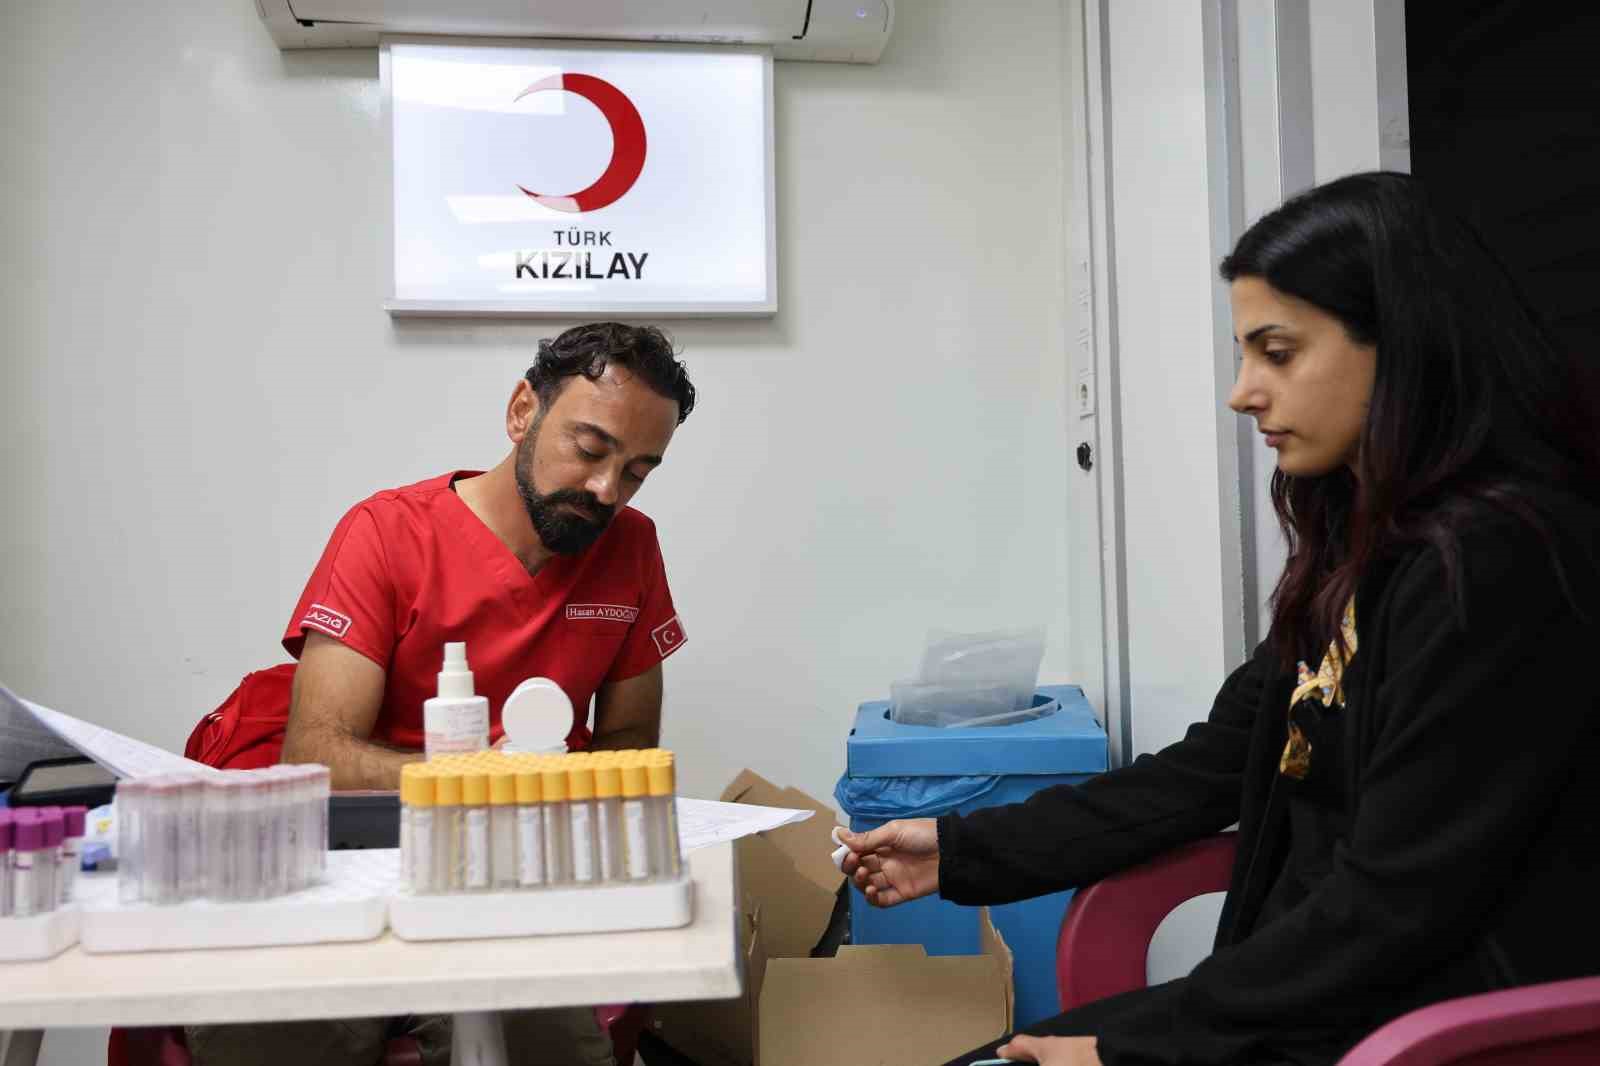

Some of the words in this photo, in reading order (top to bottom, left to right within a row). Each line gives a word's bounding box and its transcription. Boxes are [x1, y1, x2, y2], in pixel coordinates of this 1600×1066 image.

[553, 226, 612, 246] TÜRK
[515, 251, 649, 279] KIZILAY
[570, 607, 595, 617] Hasan
